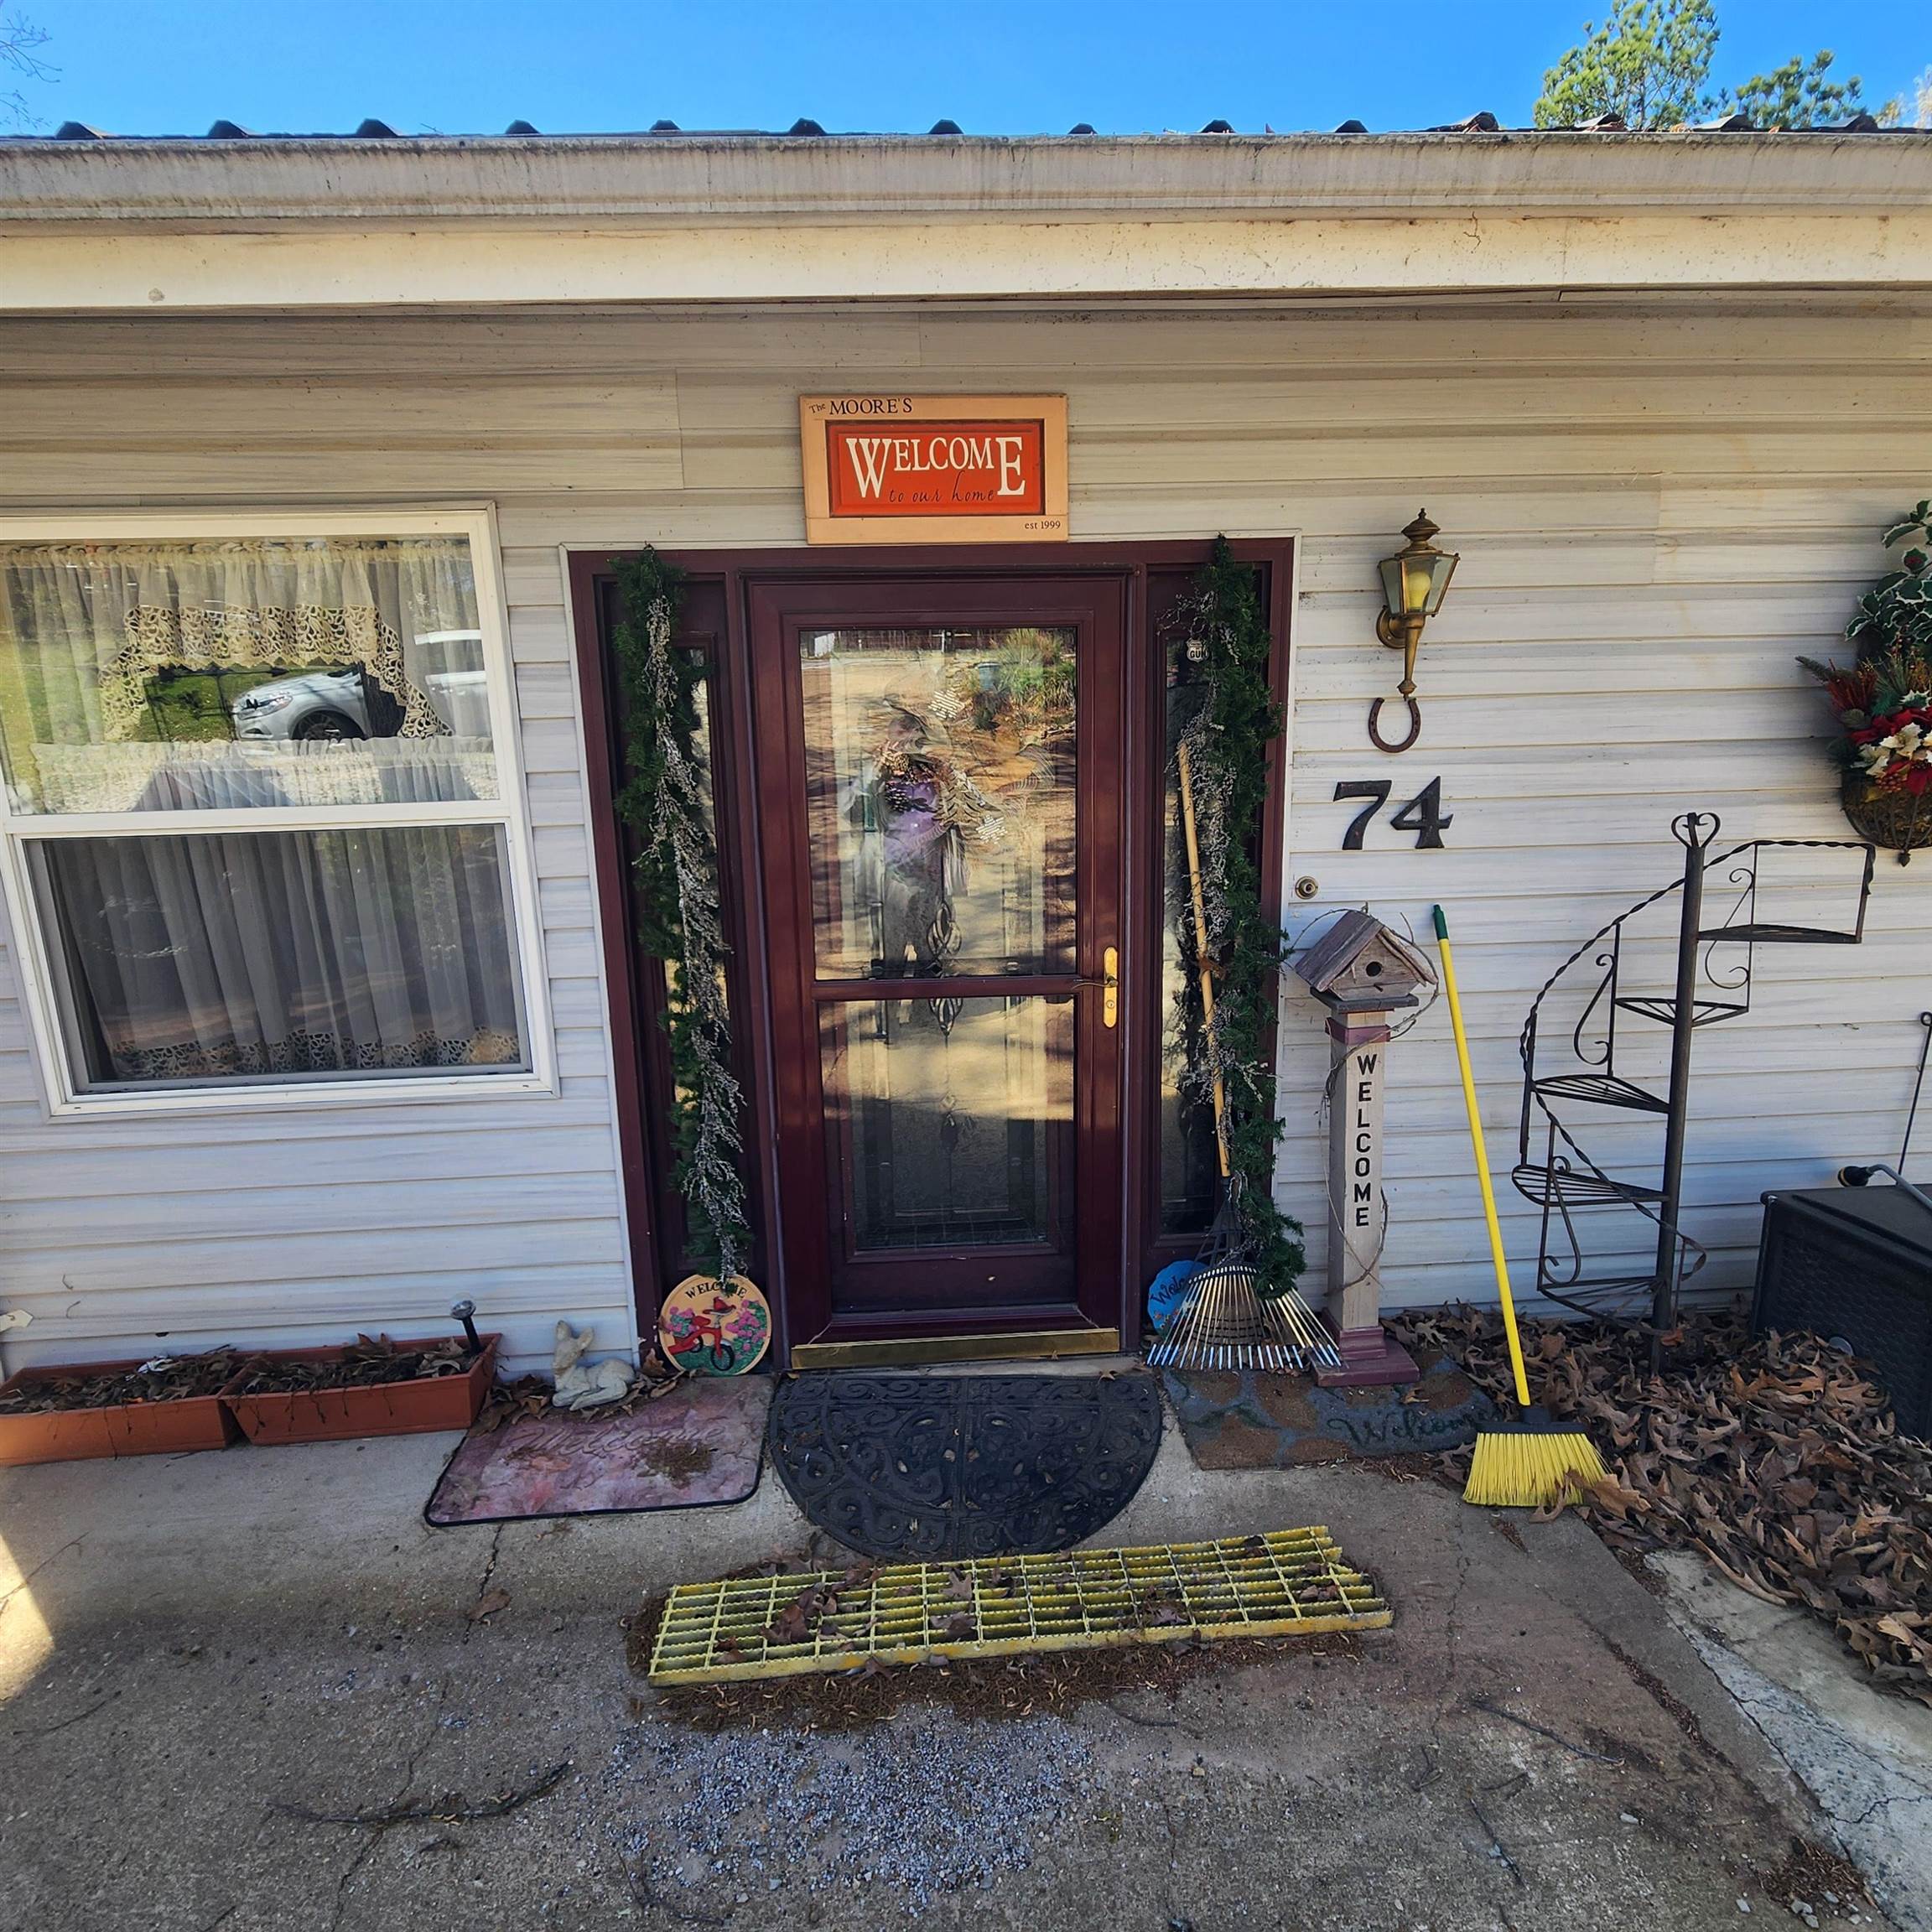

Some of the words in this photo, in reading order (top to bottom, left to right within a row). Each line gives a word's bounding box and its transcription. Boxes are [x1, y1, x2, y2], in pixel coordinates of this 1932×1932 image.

[809, 403, 826, 414] The
[829, 397, 912, 415] MOORE'S
[889, 489, 904, 502] to
[912, 490, 942, 502] our
[951, 470, 995, 501] home
[1041, 520, 1061, 529] 1999
[1333, 776, 1453, 850] 74
[1353, 1054, 1377, 1227] WELCOME
[685, 1280, 747, 1299] WELCE
